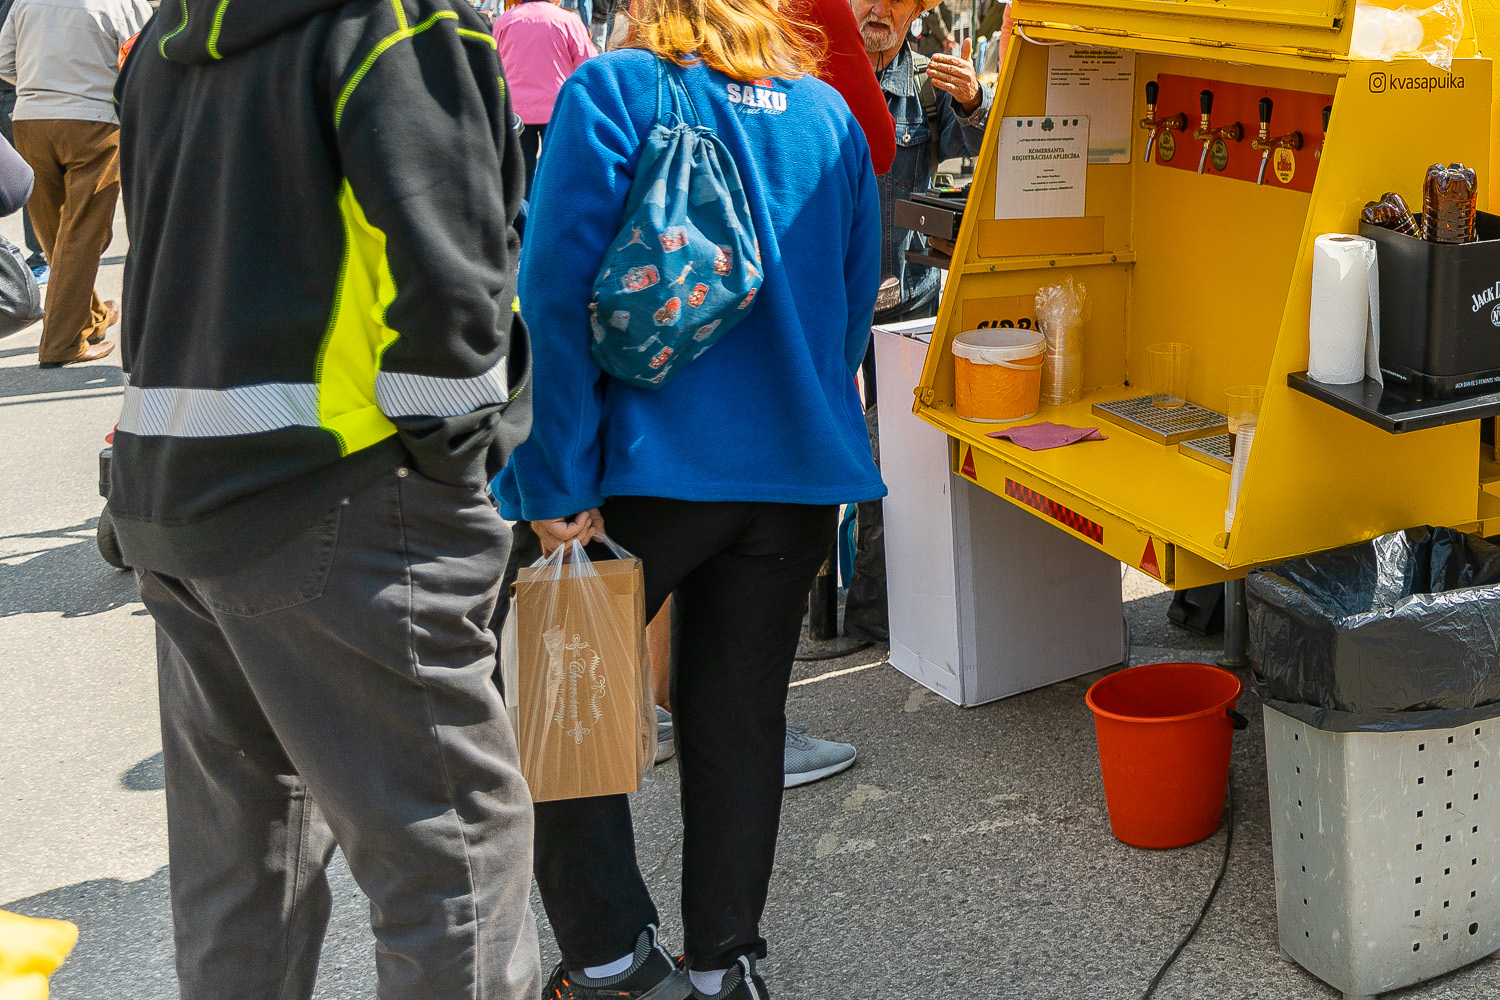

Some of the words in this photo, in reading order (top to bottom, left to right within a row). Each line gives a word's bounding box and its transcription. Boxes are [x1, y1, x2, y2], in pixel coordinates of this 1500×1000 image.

[1389, 73, 1465, 93] kvasapuika
[727, 83, 787, 111] SAKU
[1471, 286, 1495, 312] JACK
